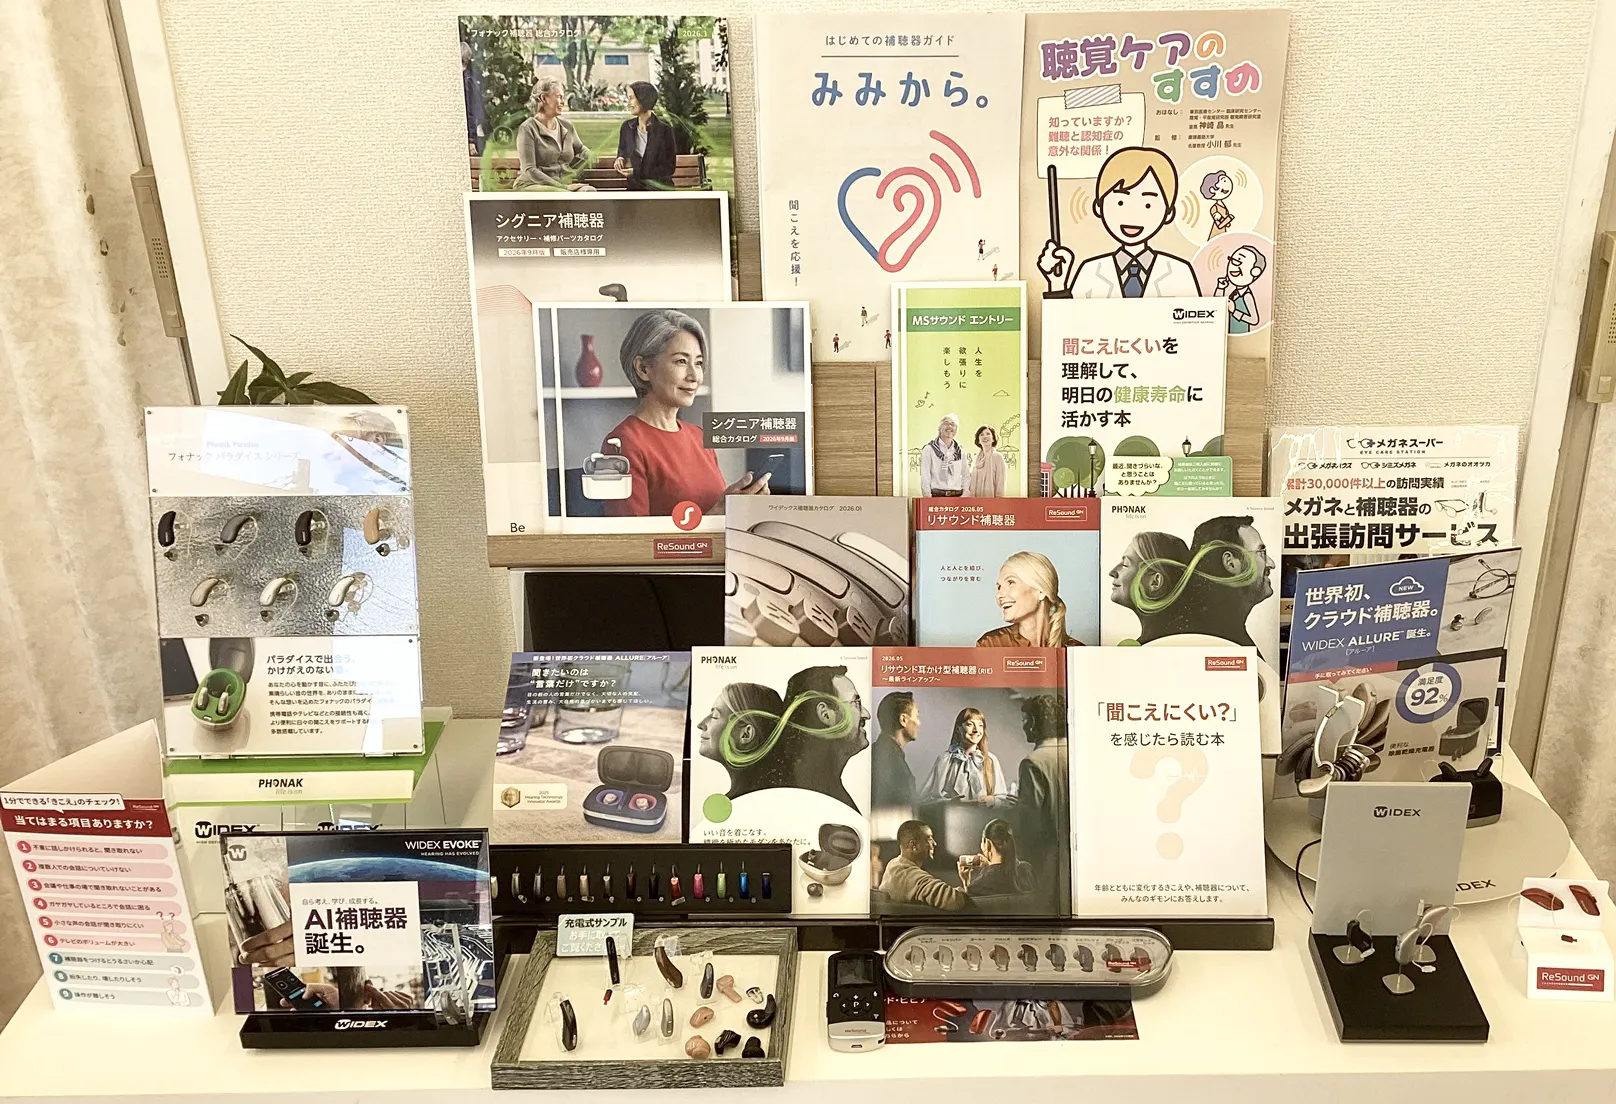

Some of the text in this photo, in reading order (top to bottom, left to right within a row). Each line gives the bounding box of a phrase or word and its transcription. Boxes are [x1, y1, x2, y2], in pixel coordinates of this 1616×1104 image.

[470, 28, 533, 38] フォナック補聴器
[535, 28, 582, 38] 総合カタログ
[825, 34, 956, 47] はじめての補聴器ガイド
[1040, 32, 1225, 81] 聴覚ケアの
[811, 70, 989, 107] みみから。
[1153, 62, 1261, 102] すすめ
[1048, 115, 1133, 128] 知っていますか？
[1048, 131, 1124, 143] 難聴と認知症の
[1048, 144, 1111, 157] 意外な関係！
[1206, 140, 1222, 148] 小川
[495, 212, 605, 230] シグニア補聴器
[496, 234, 604, 243] アクセサリー・補修パーツカタログ
[788, 199, 802, 287] 聞こえを応援！
[912, 314, 1014, 326] MSサウンド エントリー
[1172, 307, 1216, 321] WIDEX
[1061, 337, 1179, 356] 聞こえにくいを
[942, 346, 951, 389] 楽しもう
[958, 346, 967, 389] 欲張りに
[974, 346, 983, 378] 人生を
[1061, 362, 1138, 380] 理解して、
[1061, 385, 1204, 404] 明日の健康寿命に
[711, 417, 797, 430] シグニア補聴器
[1061, 409, 1132, 429] 活かす本
[712, 434, 758, 443] 総合カタログ
[1376, 438, 1444, 448] メガネスーパー
[1287, 477, 1445, 490] 累計30,000件以上の訪問実績
[1111, 505, 1146, 514] PHONAK
[1283, 496, 1432, 517] メガネと補聴器の
[927, 514, 1016, 526] リサウンド補聴器
[510, 522, 526, 533] Be
[1283, 521, 1499, 549] 出張訪問サービス
[657, 542, 695, 551] ReSound
[1305, 583, 1371, 607] 世界初、
[1303, 599, 1439, 631] クラウド補聴器。
[1302, 628, 1431, 652] WIDEX ALLURE 誕生。
[701, 656, 737, 664] PHONAK
[531, 668, 589, 677] 聞きたいのは
[1417, 676, 1444, 687] 満足度
[1110, 732, 1225, 747] を感じたら読む本
[258, 778, 304, 788] PHONAK
[1373, 805, 1421, 818] WIDEX
[703, 828, 767, 837] いい音を着こなす。
[404, 840, 480, 850] WIDEX EVOKE
[1094, 883, 1250, 893] 年齢とともに変化するきこえや、補聴器について、
[302, 898, 379, 906] 自ら考え、学び、成長する。
[1120, 894, 1224, 904] みんなのギモンにお答えします。
[304, 907, 408, 931] AI補聴器
[564, 917, 628, 929] 充電式サンプル
[305, 932, 366, 956] 誕生。
[561, 942, 607, 953] ご覧くださ
[1541, 971, 1600, 982] ReSound GN
[334, 1019, 388, 1030] WIDEX
